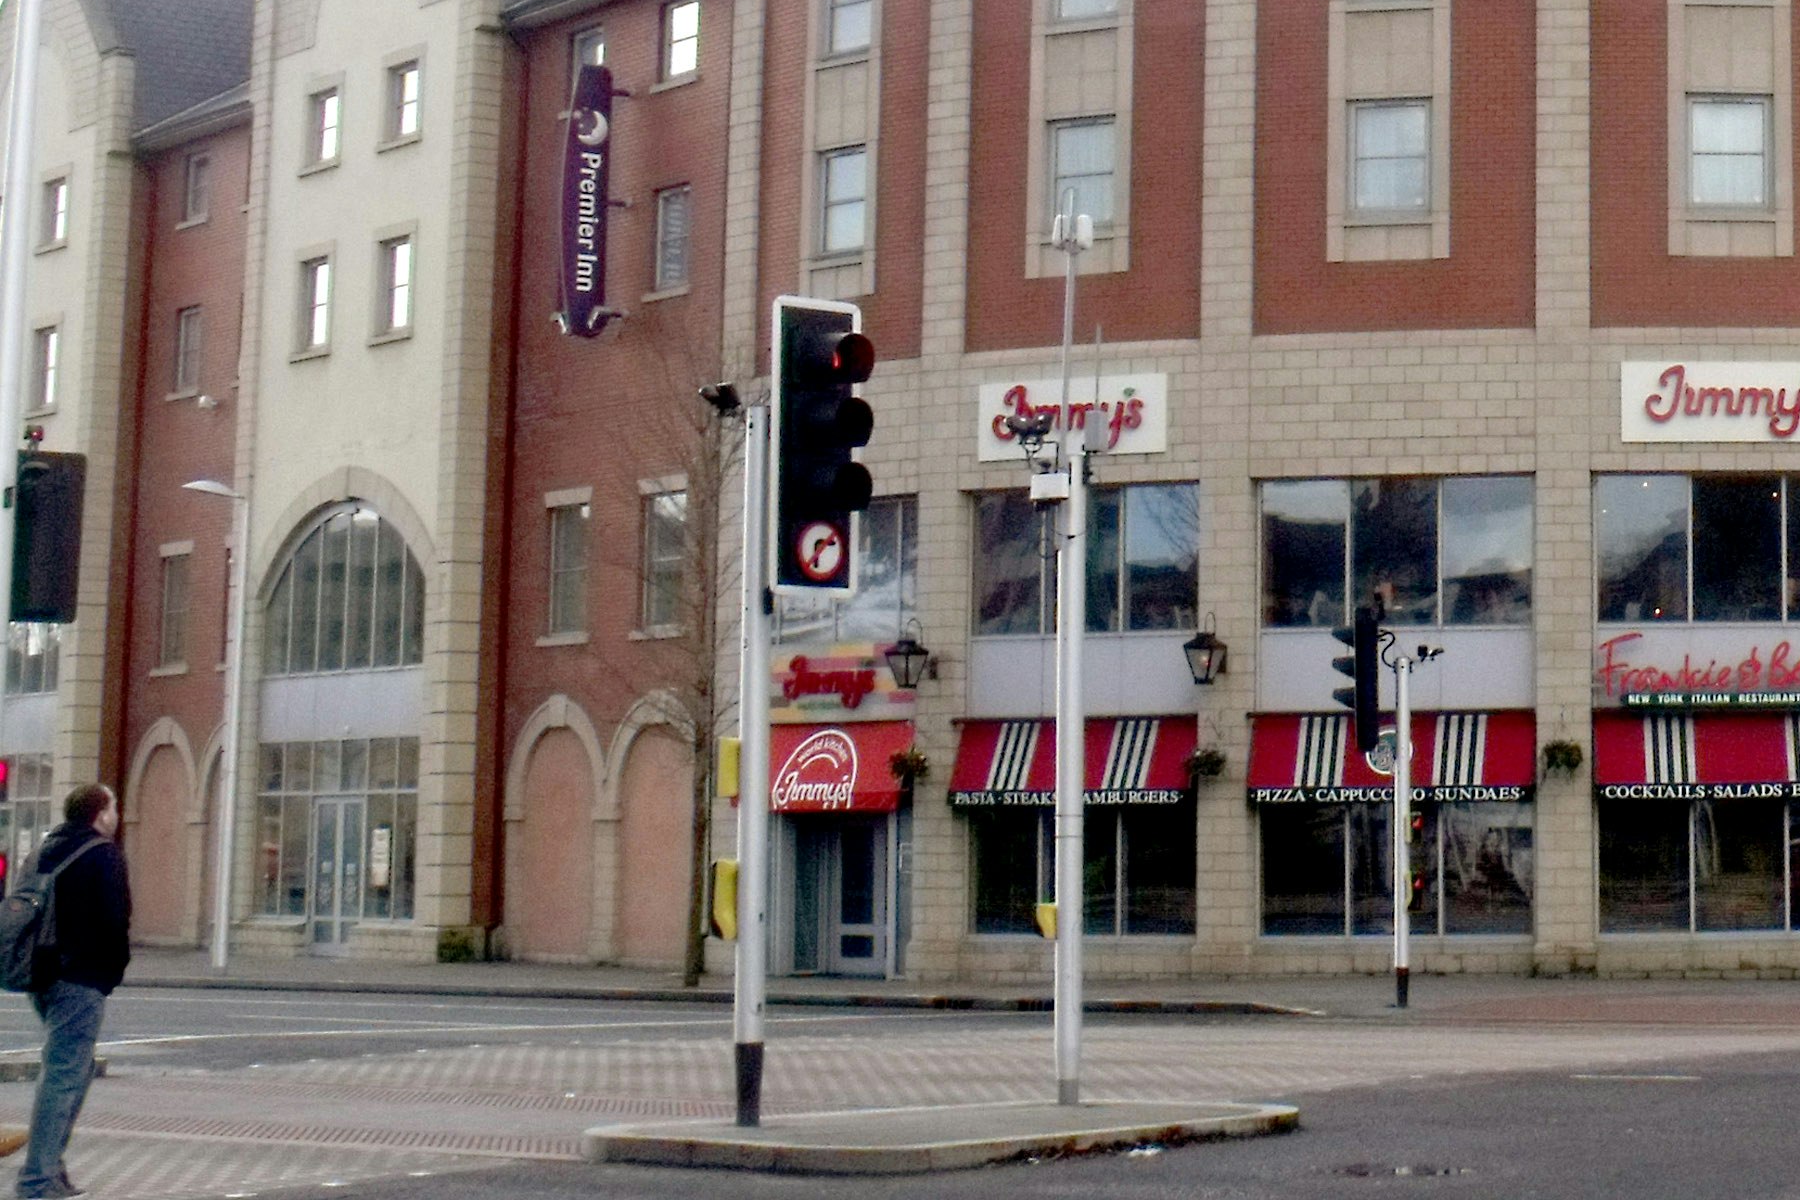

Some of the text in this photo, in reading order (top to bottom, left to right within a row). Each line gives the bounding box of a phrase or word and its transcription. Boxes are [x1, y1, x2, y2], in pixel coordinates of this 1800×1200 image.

[575, 151, 602, 293] Premier Inn
[1598, 632, 1733, 697] Frankie
[1738, 646, 1763, 690] &
[1627, 694, 1651, 704] NEW
[1657, 694, 1684, 704] YORK
[1690, 694, 1731, 703] ITALIAN
[1738, 693, 1800, 703] RESTAURANT
[776, 770, 851, 809] Jimmy's
[954, 792, 996, 805] PASTA
[1082, 790, 1179, 804] AMBURGERS
[1256, 786, 1521, 802] PIZZA CAPPUCCO SUNDAES
[1604, 784, 1706, 799] COCKTAILS
[1713, 784, 1783, 798] SALADS
